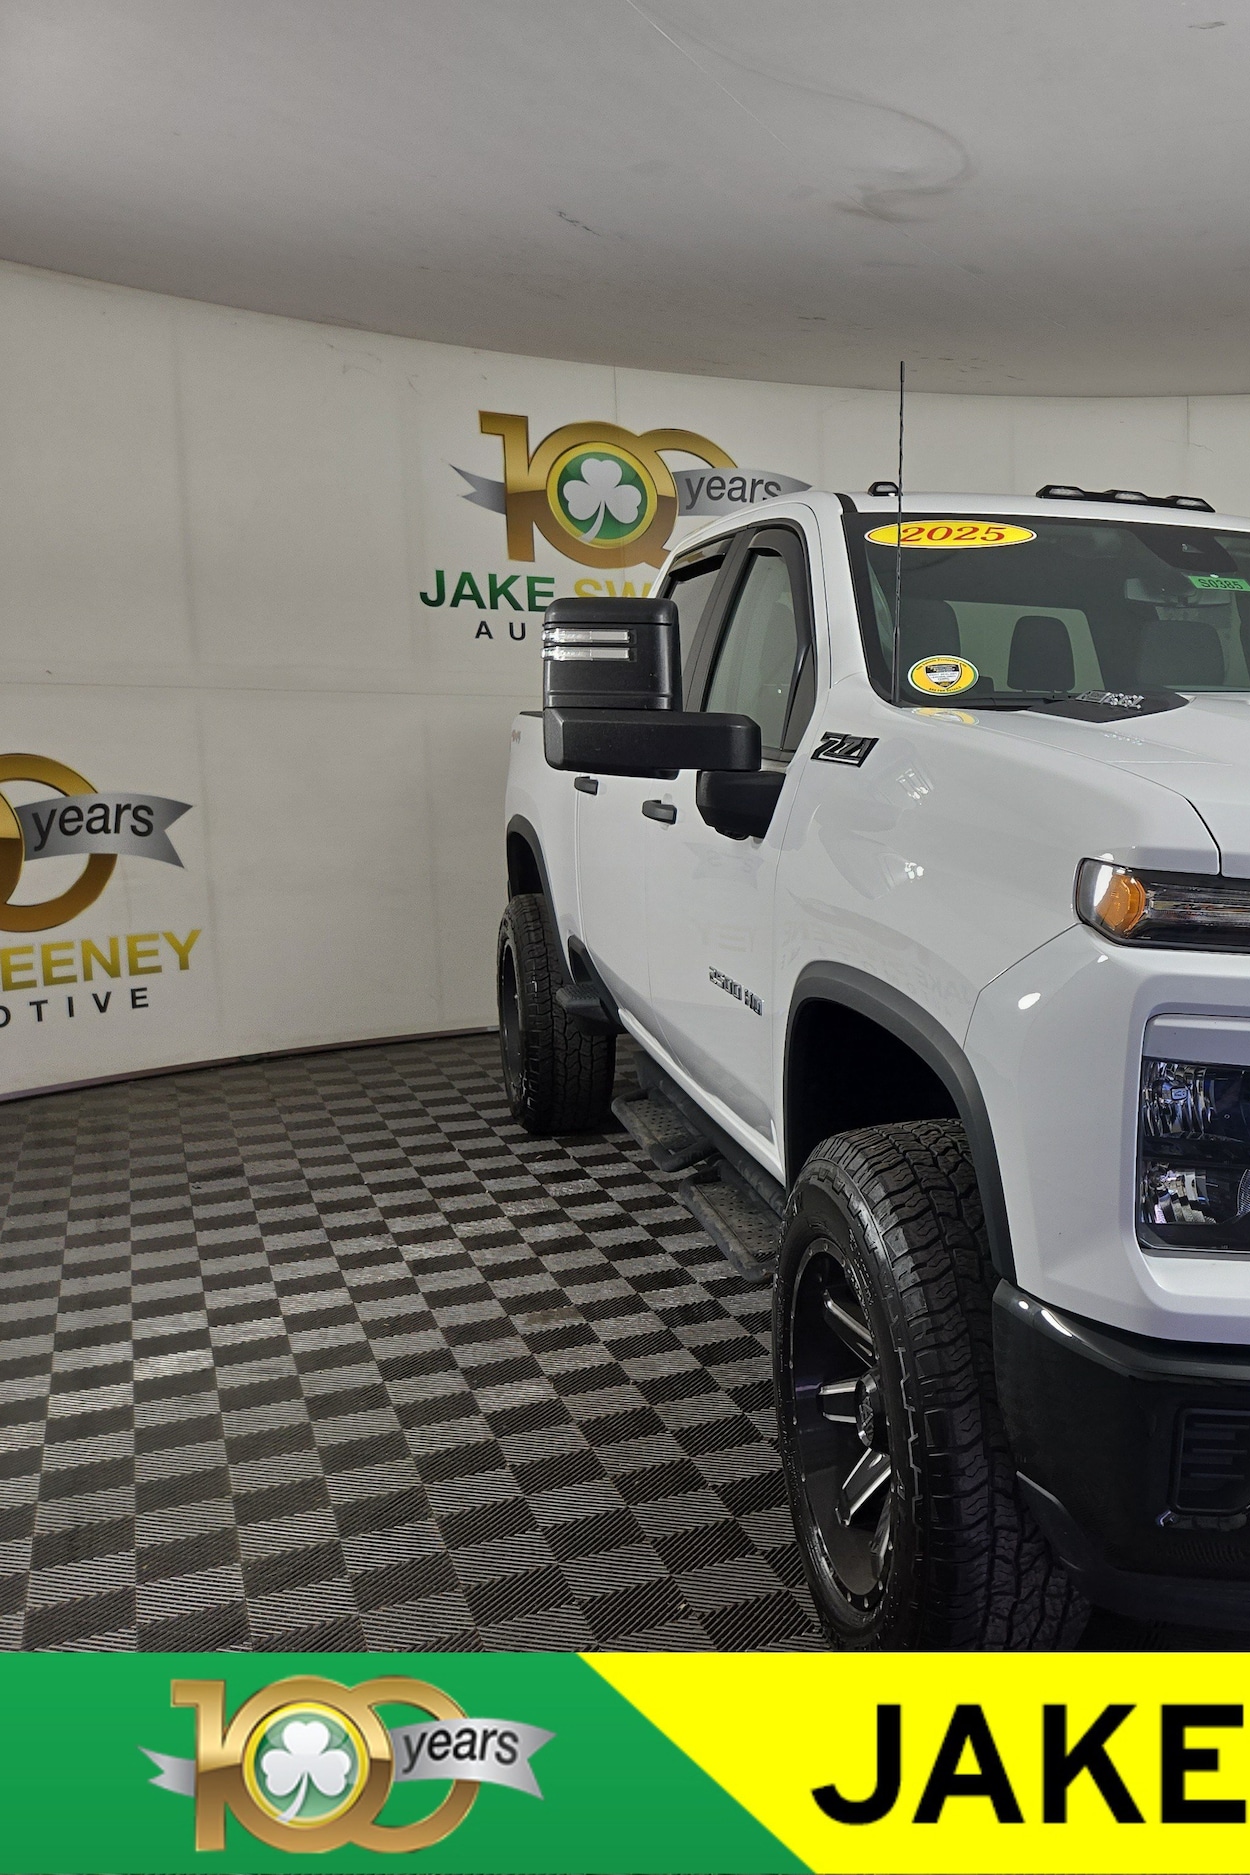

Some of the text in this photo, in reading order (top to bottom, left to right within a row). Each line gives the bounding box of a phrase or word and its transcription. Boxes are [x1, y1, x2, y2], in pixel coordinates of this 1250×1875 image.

[900, 525, 1007, 543] 2025
[419, 569, 555, 613] JAKE
[32, 802, 154, 851] years
[0, 929, 202, 992] EENEY
[0, 987, 149, 1028] OTIVE
